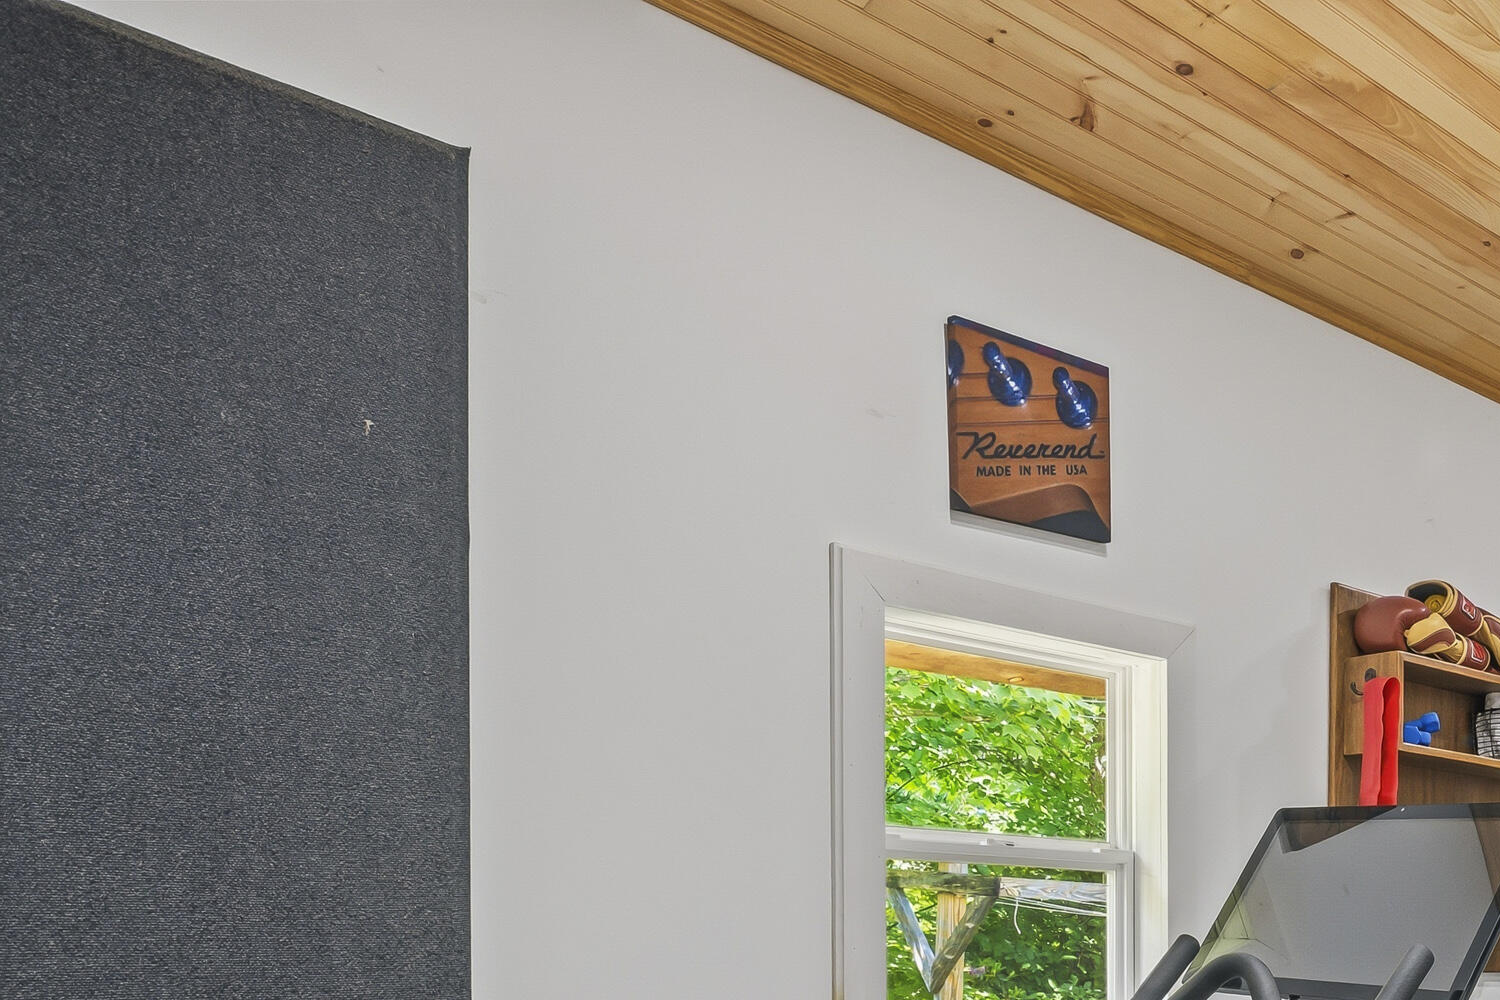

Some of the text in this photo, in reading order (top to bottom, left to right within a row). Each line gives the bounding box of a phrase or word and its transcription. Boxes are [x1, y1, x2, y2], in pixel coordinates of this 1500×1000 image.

[956, 432, 1105, 460] Reverend
[976, 464, 1087, 477] MADE IN THE USA
